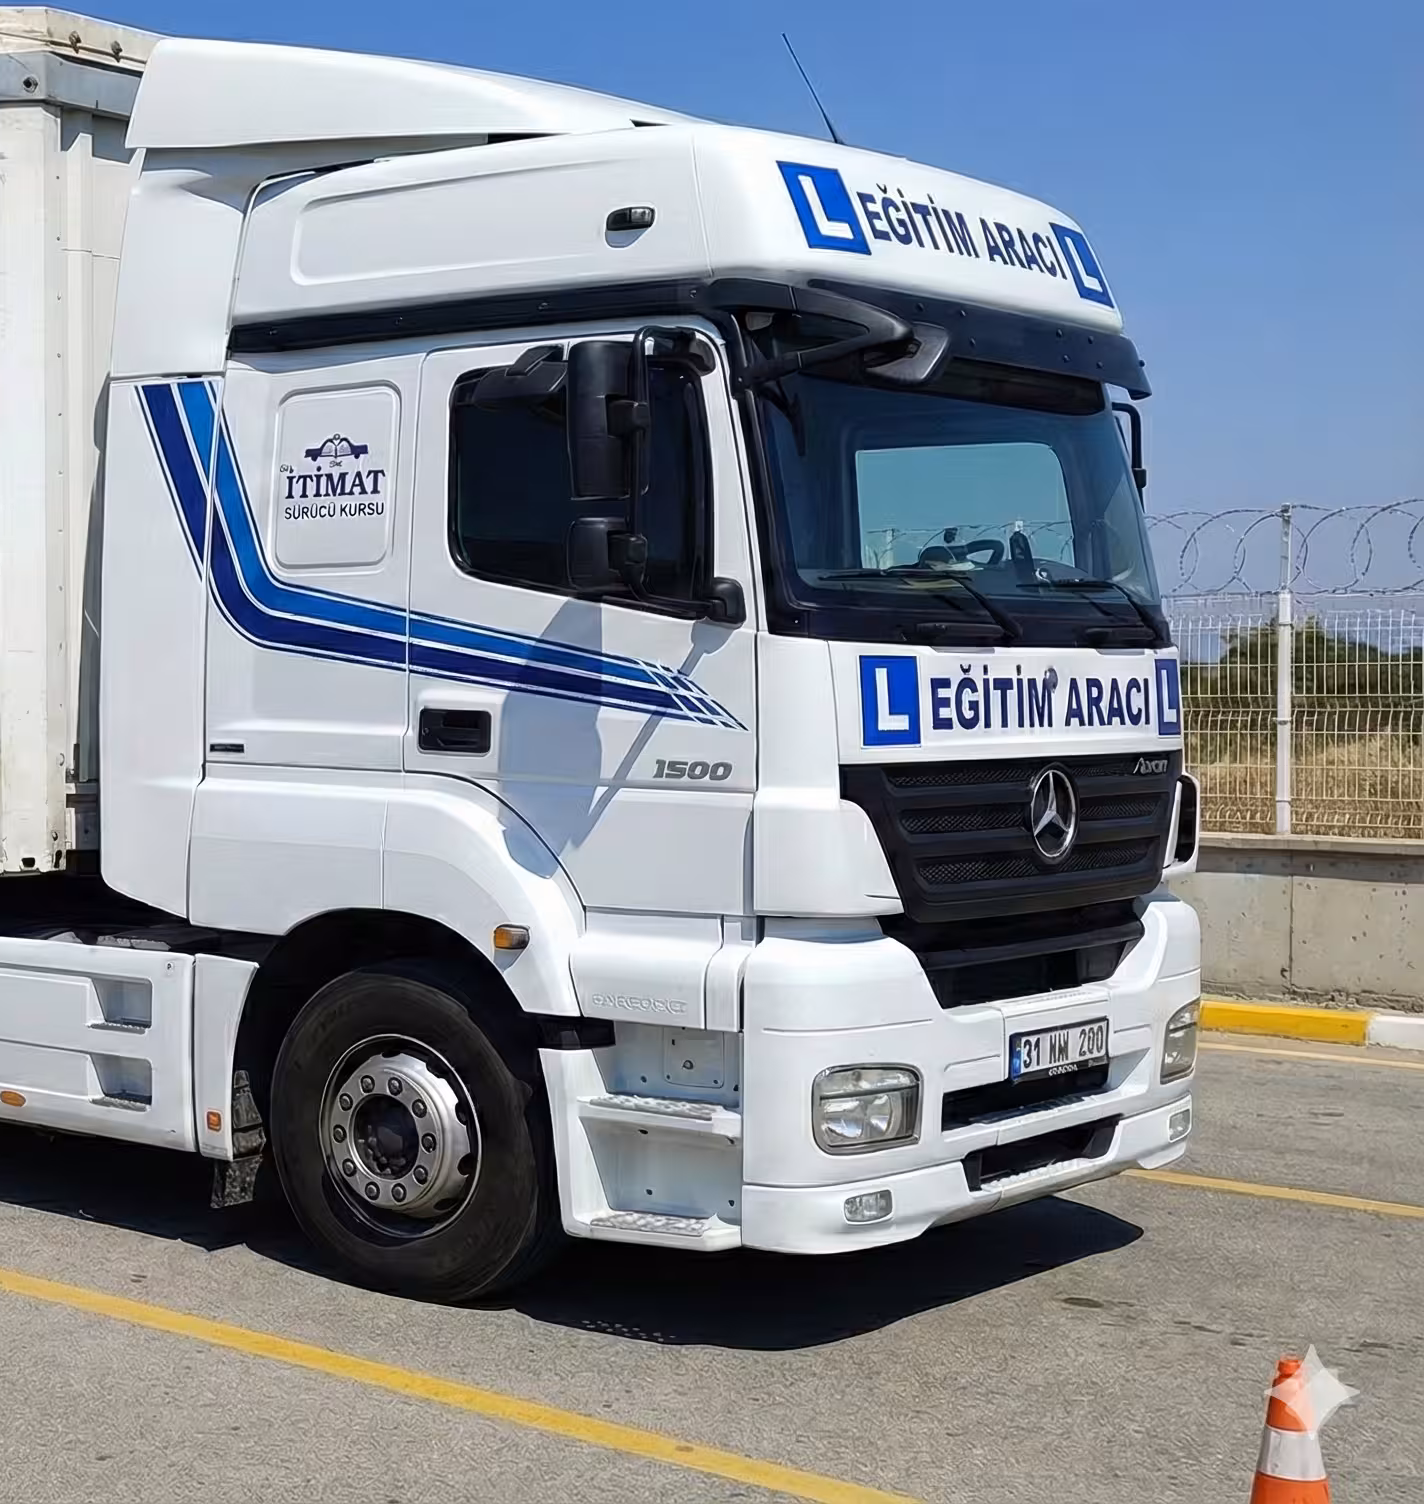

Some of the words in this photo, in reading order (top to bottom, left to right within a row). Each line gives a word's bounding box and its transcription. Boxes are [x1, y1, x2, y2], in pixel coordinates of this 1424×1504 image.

[857, 184, 980, 258] EĞİTİM
[979, 217, 1068, 280] ARACI
[340, 502, 384, 517] KURSU
[930, 664, 1054, 730] EĞİTİM
[1064, 678, 1151, 727] ARACI
[652, 759, 733, 781] 1500
[1023, 1037, 1041, 1069] 31
